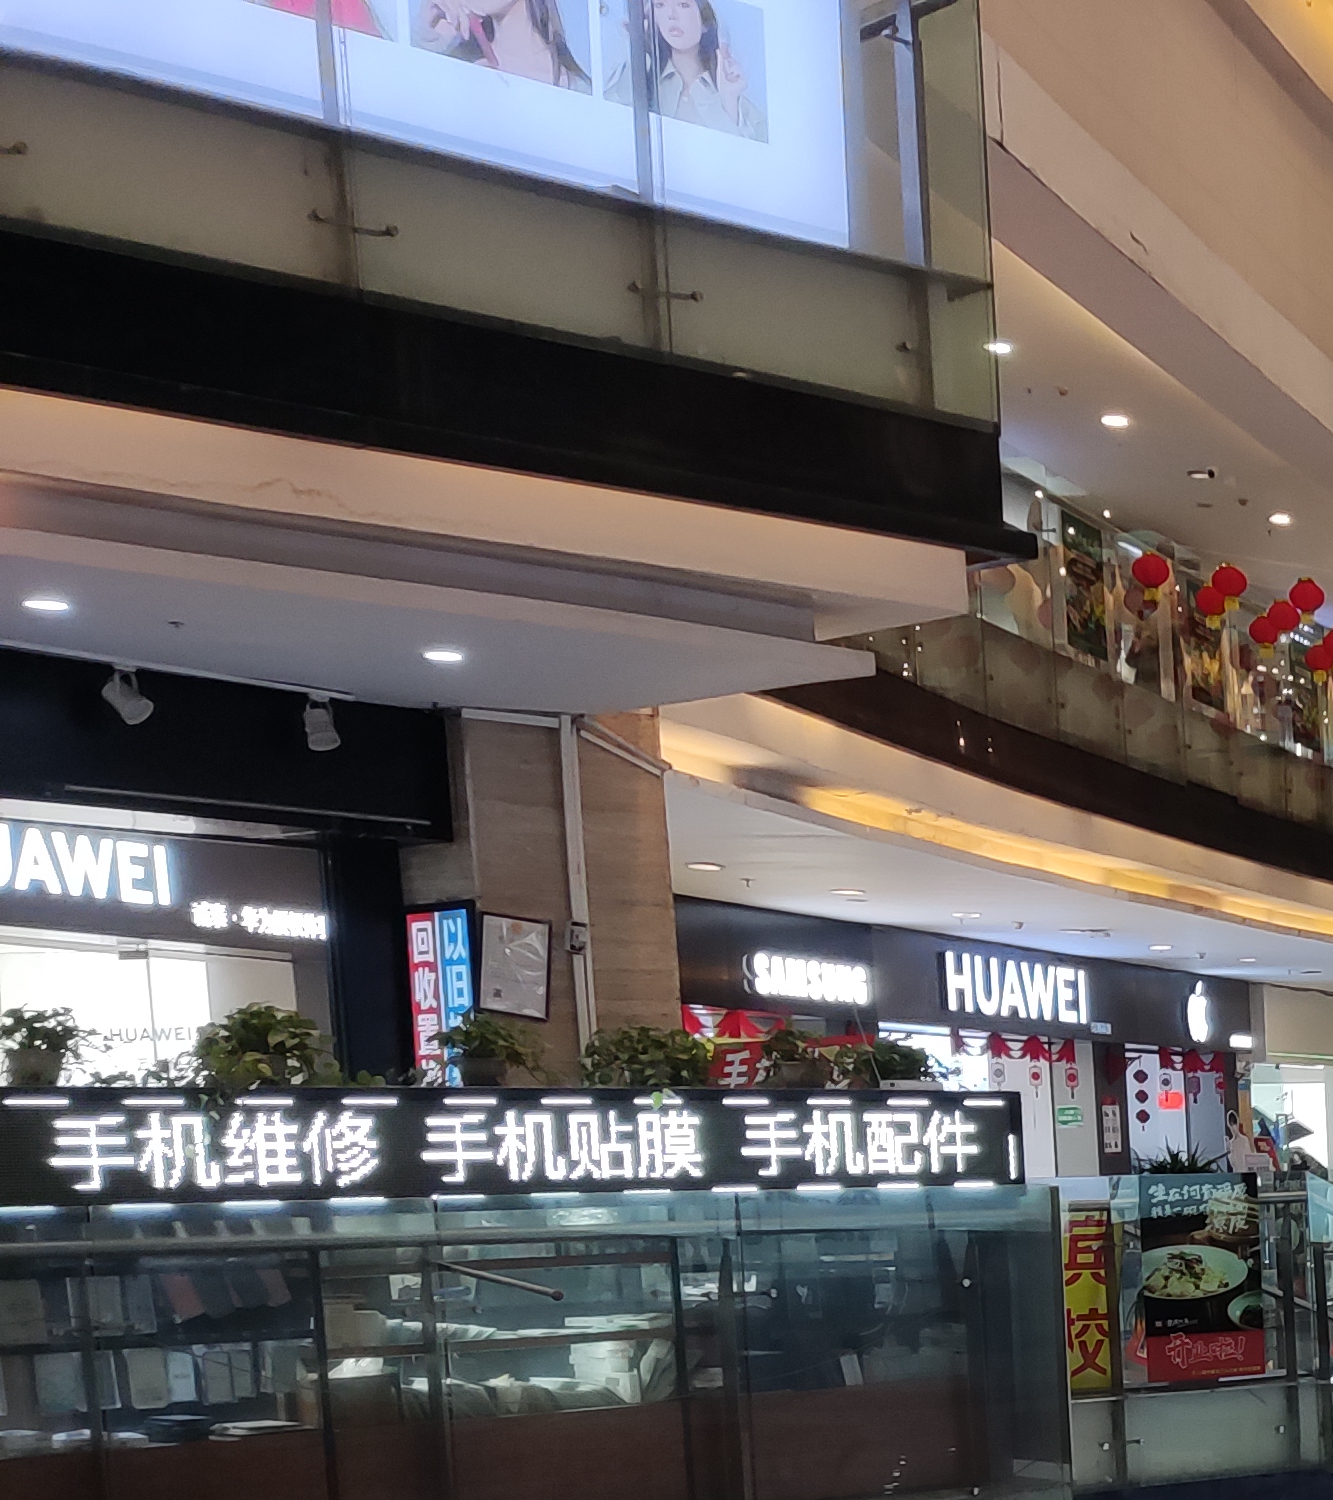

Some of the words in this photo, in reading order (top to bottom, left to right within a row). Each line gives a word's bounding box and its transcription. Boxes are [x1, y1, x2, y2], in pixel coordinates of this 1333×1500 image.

[753, 951, 868, 1006] SAMSUNG
[944, 950, 1089, 1025] HUAWEI
[109, 1026, 192, 1042] HUAWEI
[48, 1112, 380, 1192] 手机维修
[420, 1109, 703, 1184] 手机贴膜
[740, 1109, 981, 1178] 手机配件
